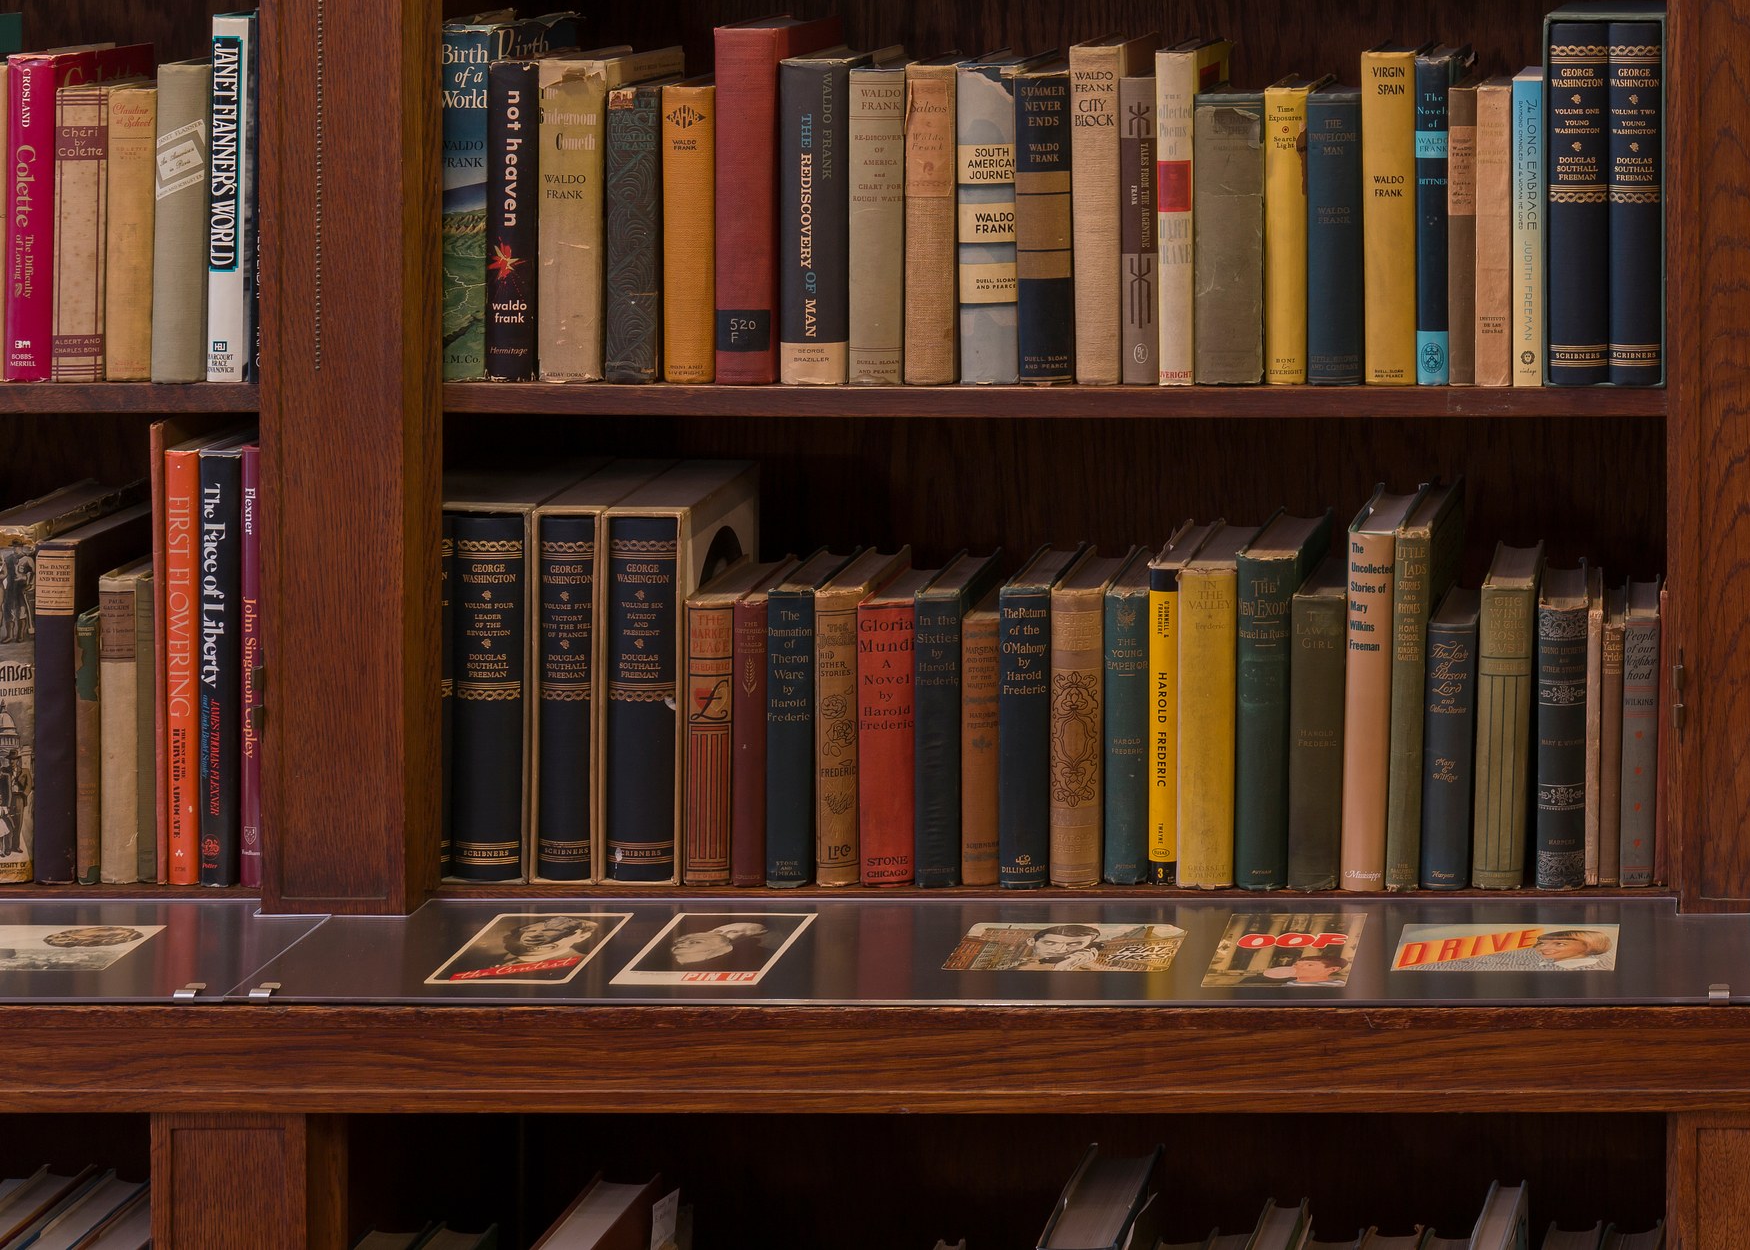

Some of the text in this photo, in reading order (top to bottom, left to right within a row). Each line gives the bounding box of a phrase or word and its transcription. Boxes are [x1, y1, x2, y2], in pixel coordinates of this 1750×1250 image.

[1371, 66, 1405, 78] VIRGIN
[1560, 68, 1594, 77] GEORGE
[1552, 78, 1604, 88] WASHINGTON
[1378, 84, 1405, 96] SPAIN
[1078, 100, 1106, 114] CITY
[1074, 114, 1114, 128] BLOCK
[62, 128, 98, 137] Chéri
[15, 68, 36, 227] CROSLAND Colette
[58, 147, 103, 157] Colette
[210, 43, 238, 266] JANET FLANNER'S WORLD
[504, 90, 522, 227] not heaven
[1559, 156, 1596, 165] DOUGLAS
[1556, 165, 1598, 173] SOUTHALL
[1558, 173, 1596, 181] FREEMAN
[800, 113, 816, 337] THE REDISCOVERY OF MAN
[492, 301, 527, 310] waldo
[494, 314, 524, 324] frank
[730, 319, 756, 331] 520
[1352, 544, 1364, 554] The
[1351, 563, 1393, 574] Uncollected
[201, 483, 226, 689] The Face of Liberty
[1350, 582, 1386, 594] Stories of
[169, 496, 190, 719] FIRST FLOWERING
[1350, 602, 1368, 614] Mary
[859, 617, 914, 633] Gloria
[1350, 621, 1375, 633] Wilkins
[1348, 640, 1380, 652] Freeman
[882, 660, 891, 669] A
[864, 674, 909, 687] Novel
[878, 690, 893, 702] by
[863, 705, 910, 717] Harold
[860, 719, 913, 731] Frederic
[1157, 672, 1167, 787] HAROLD FREDERIC
[1238, 933, 1349, 950] OOF
[1399, 928, 1545, 967] DRIVE
[685, 972, 755, 981] PIN UP
